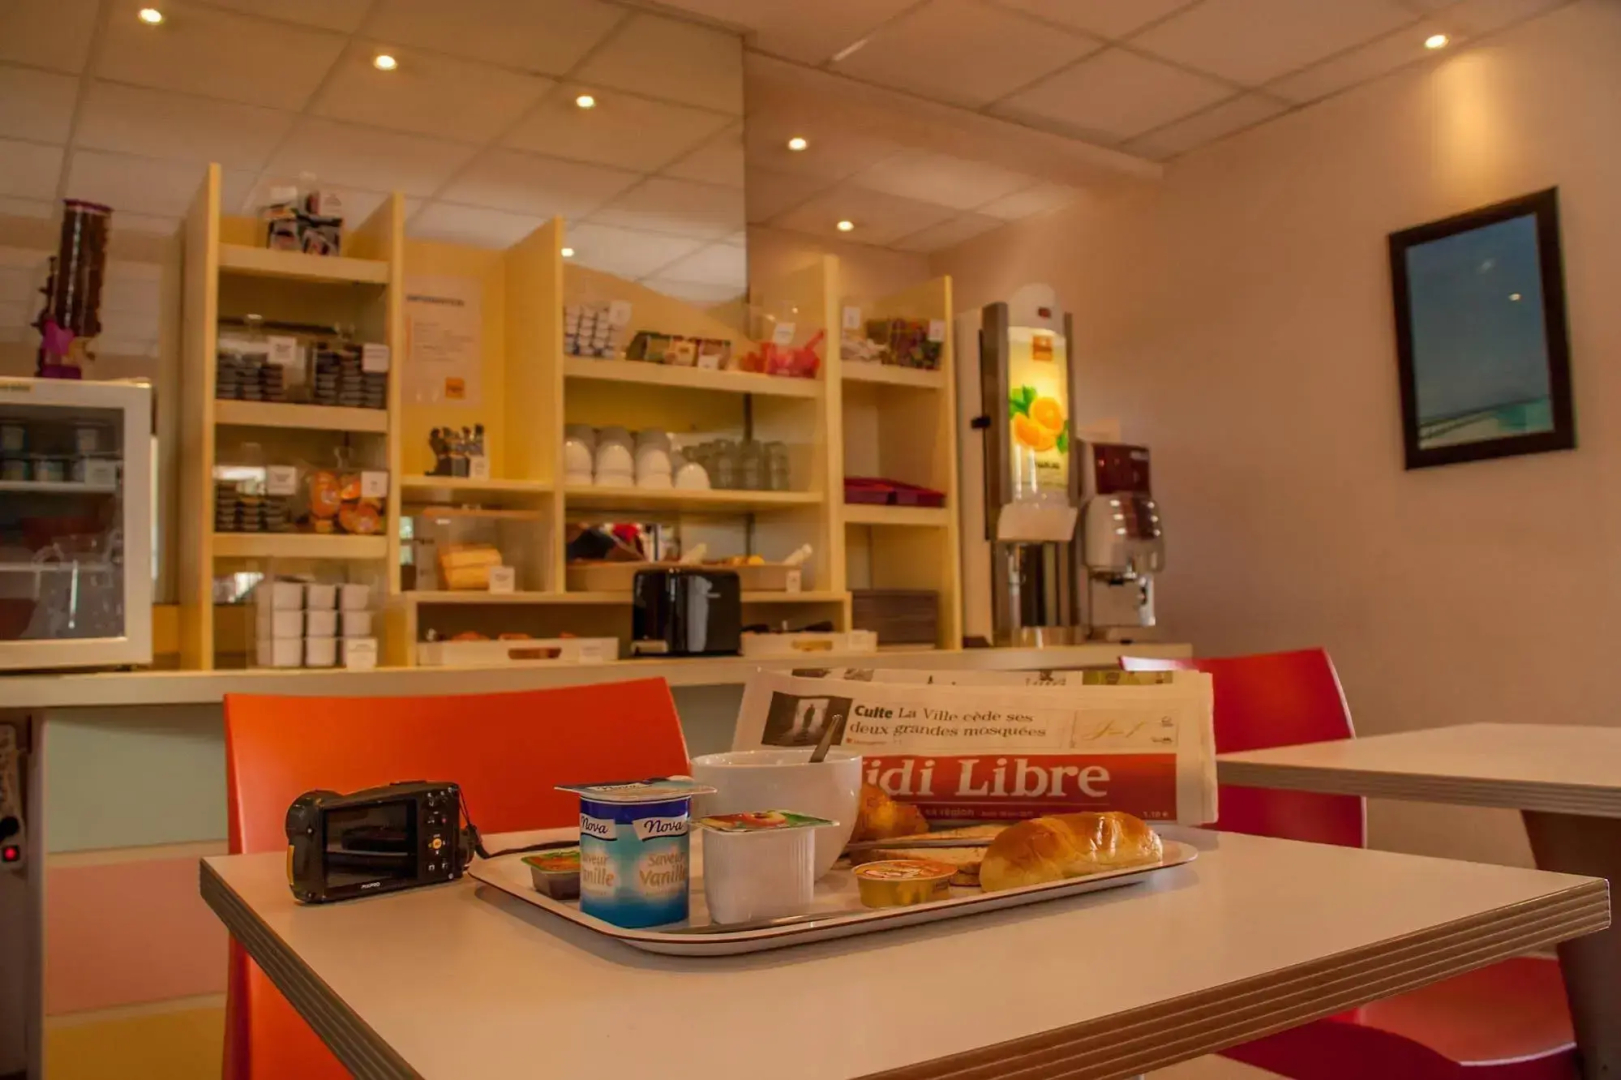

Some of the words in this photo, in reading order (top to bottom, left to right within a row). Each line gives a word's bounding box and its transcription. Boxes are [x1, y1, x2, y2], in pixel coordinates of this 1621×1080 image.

[854, 704, 893, 719] Culte
[898, 706, 917, 719] La
[922, 708, 959, 721] Ville
[963, 710, 1002, 722] cède
[1005, 714, 1035, 722] ses
[850, 721, 889, 735] deux
[893, 723, 959, 737] grandes
[963, 724, 1047, 738] mosquées
[862, 758, 934, 796] idi
[955, 758, 1110, 798] Libre
[581, 816, 608, 834] Nova
[643, 819, 683, 833] Nova
[581, 853, 608, 867] aveur
[582, 866, 615, 887] anille
